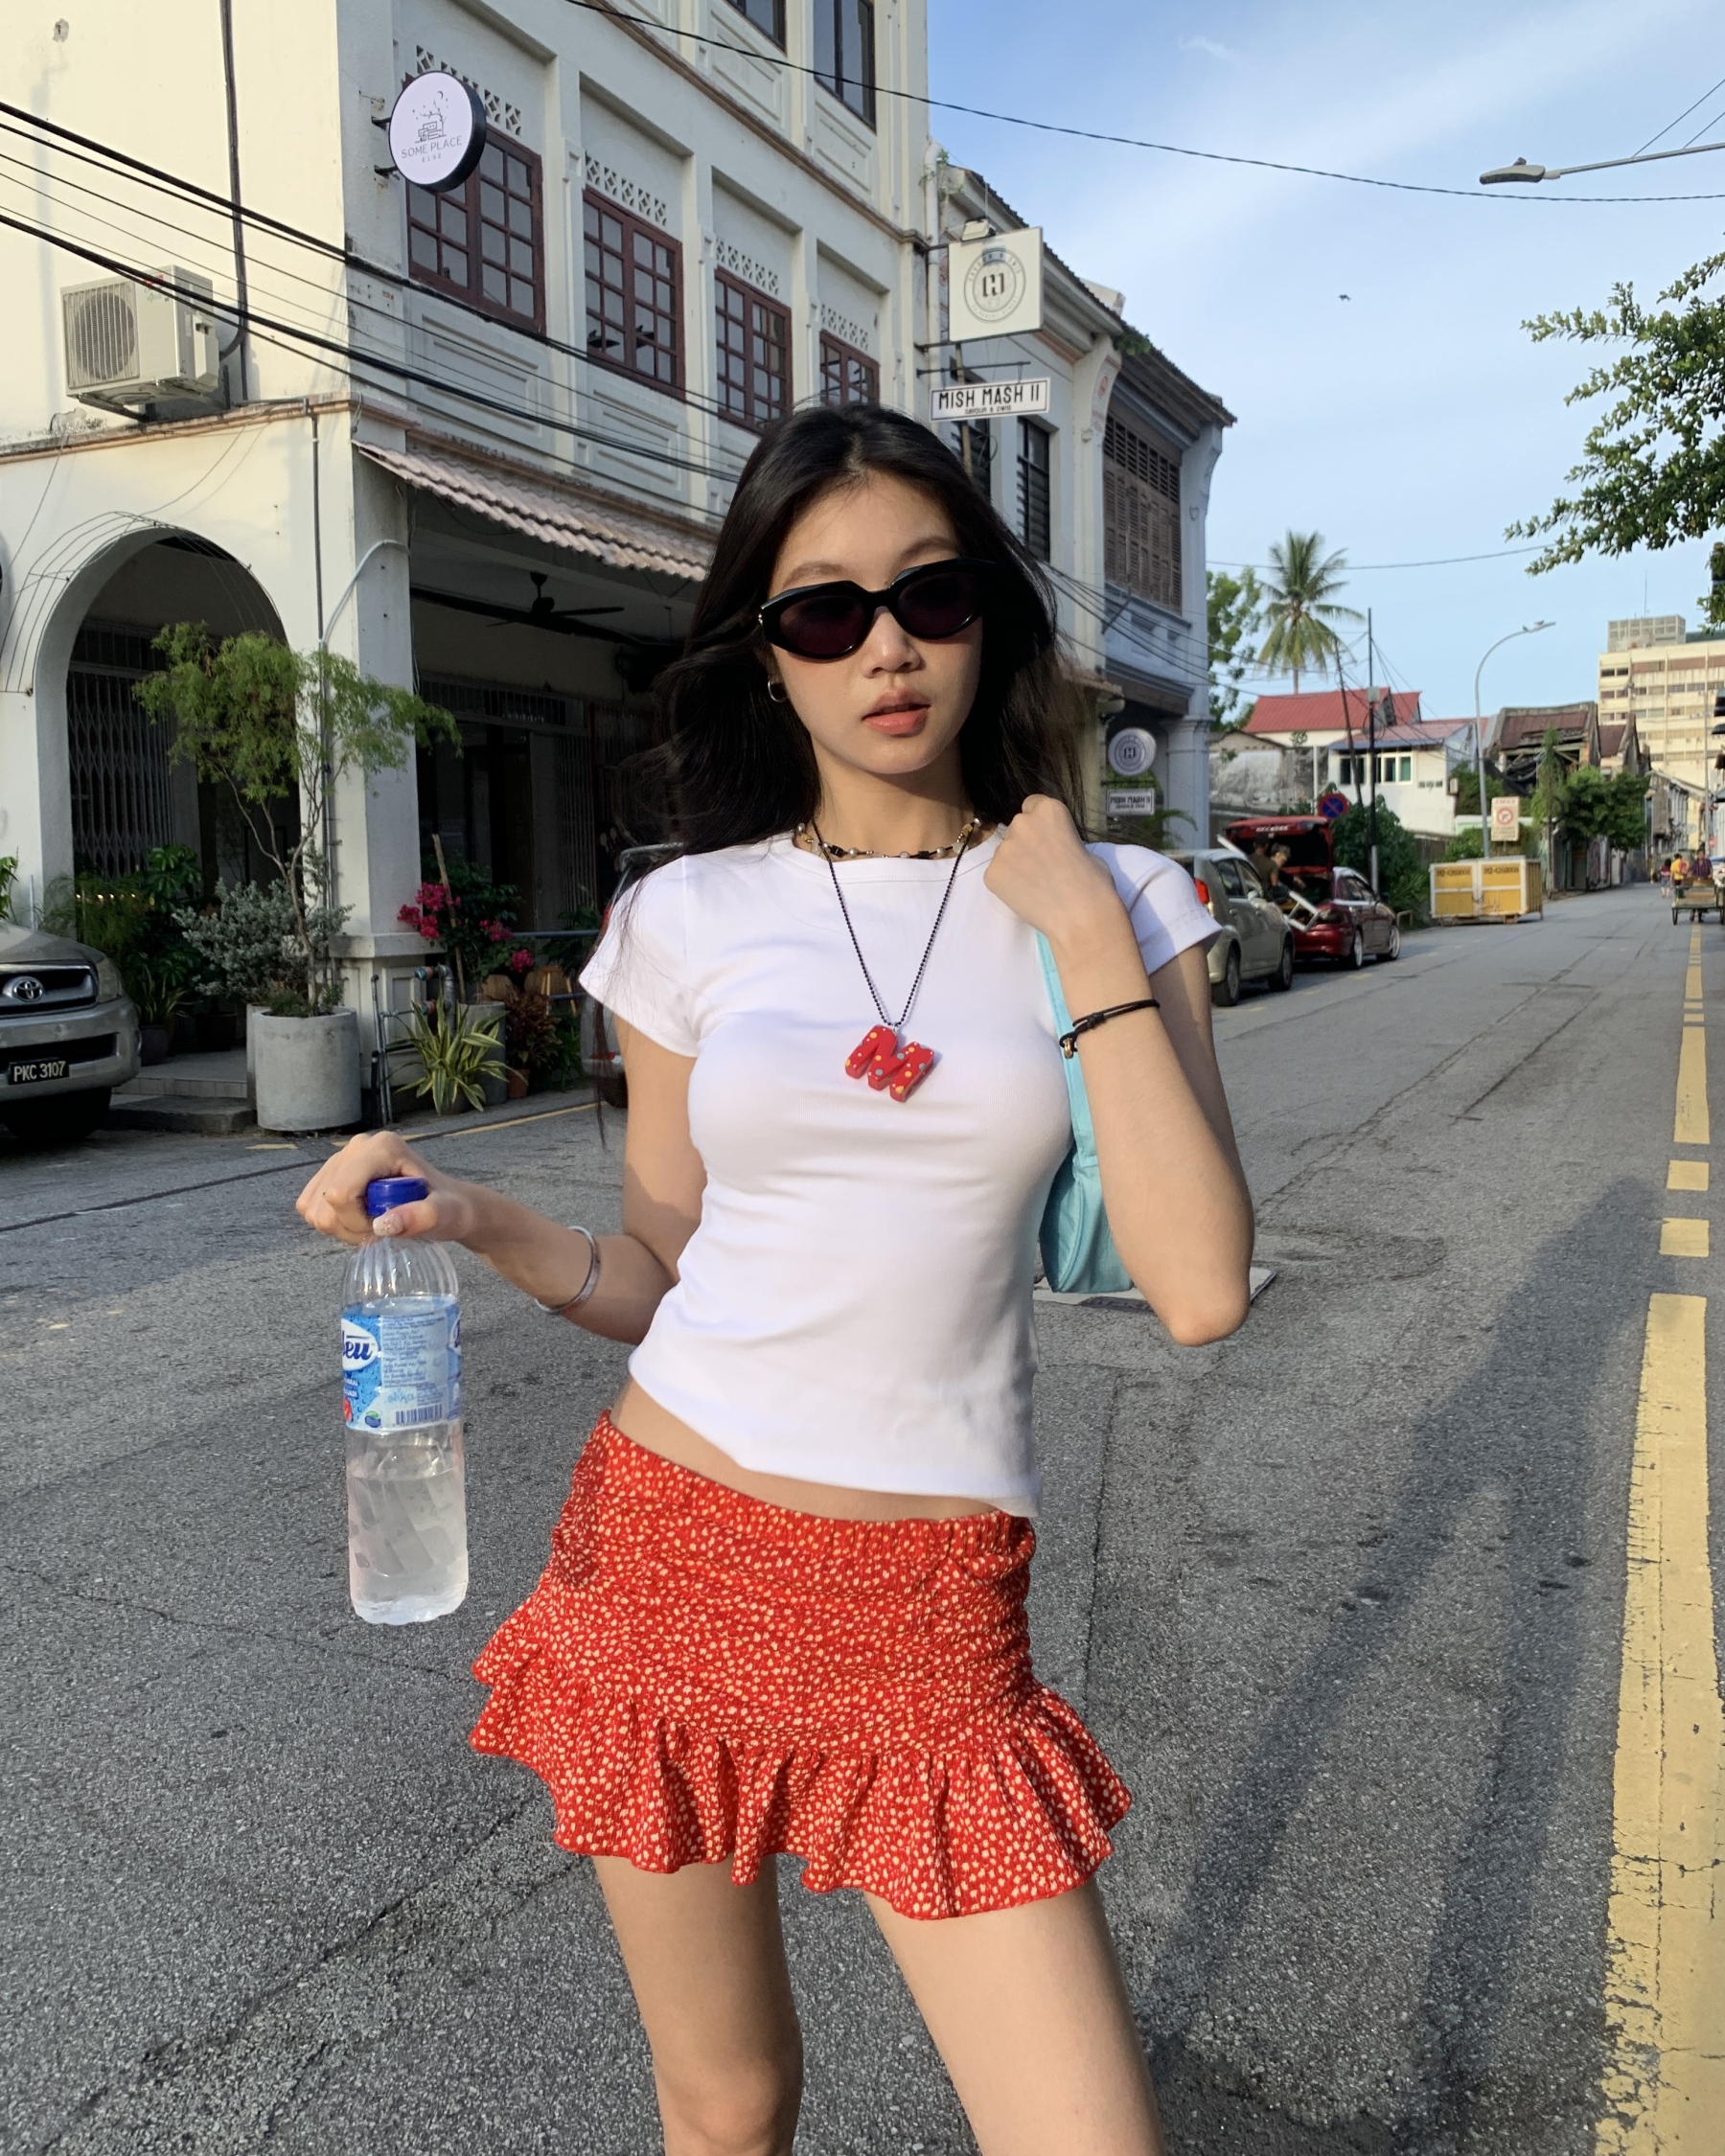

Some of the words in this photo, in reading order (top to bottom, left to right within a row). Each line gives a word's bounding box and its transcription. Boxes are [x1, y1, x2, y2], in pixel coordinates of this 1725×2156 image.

[402, 144, 427, 158] SOME
[430, 135, 462, 151] PLACE
[422, 152, 442, 163] ELSE
[938, 389, 975, 410] MISH
[982, 385, 1024, 406] MASH
[1030, 383, 1040, 401] II
[13, 1064, 37, 1083] PKC
[39, 1060, 66, 1079] 3107
